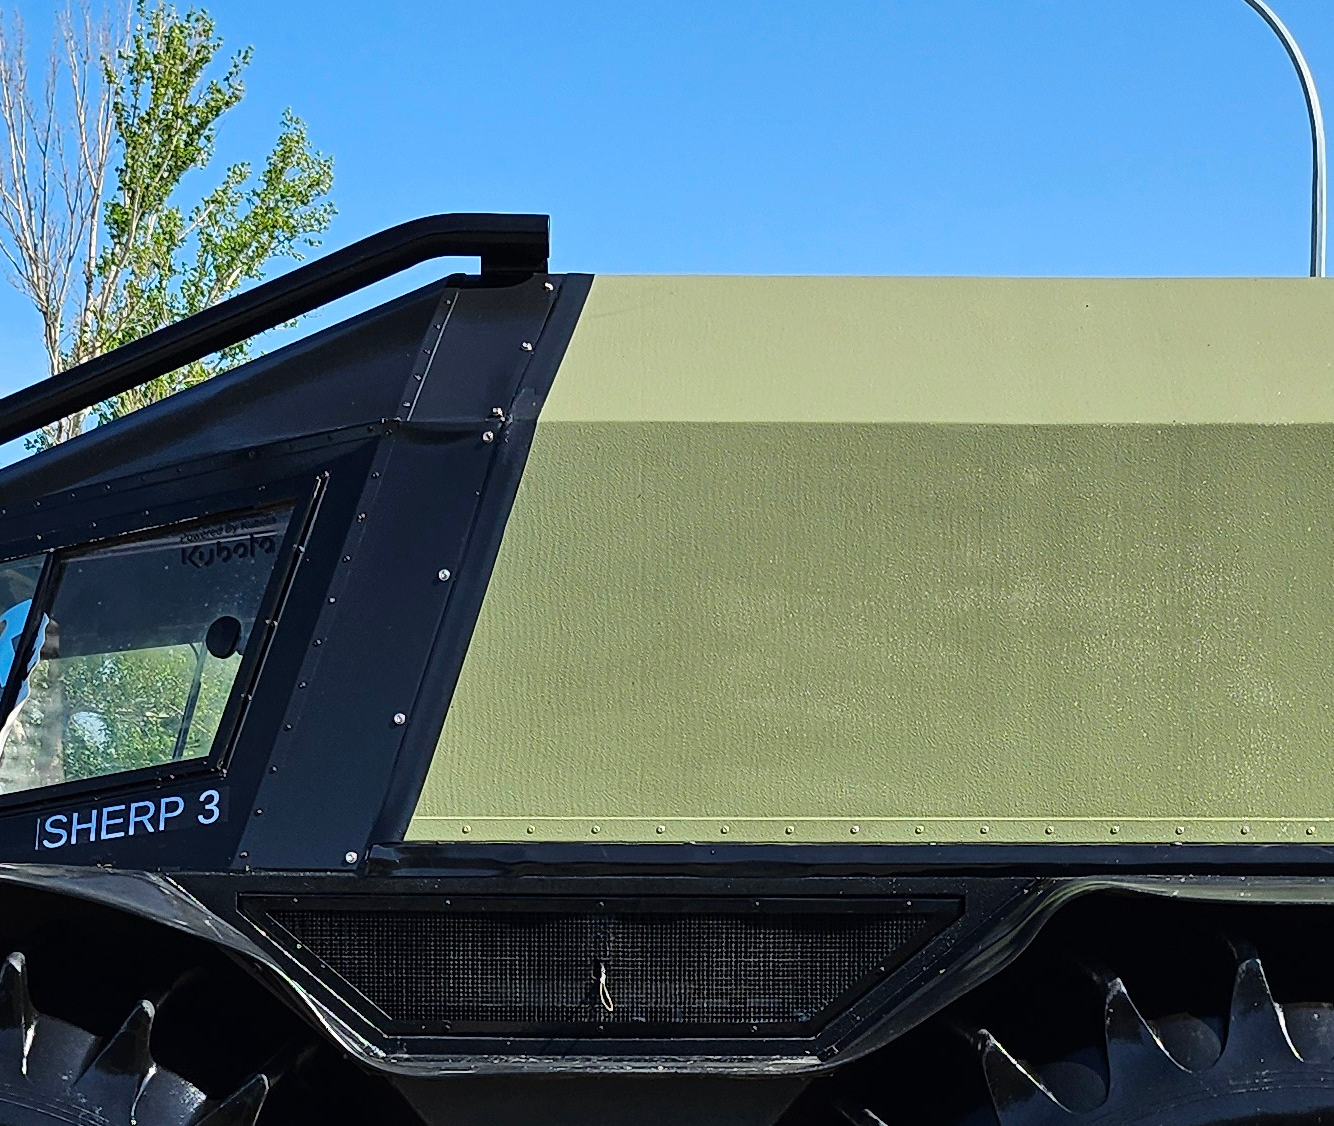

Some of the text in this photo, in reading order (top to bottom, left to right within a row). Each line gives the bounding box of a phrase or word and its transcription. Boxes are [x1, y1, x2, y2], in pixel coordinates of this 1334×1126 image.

[181, 533, 276, 569] Kubota
[42, 789, 221, 849] SHERP 3
